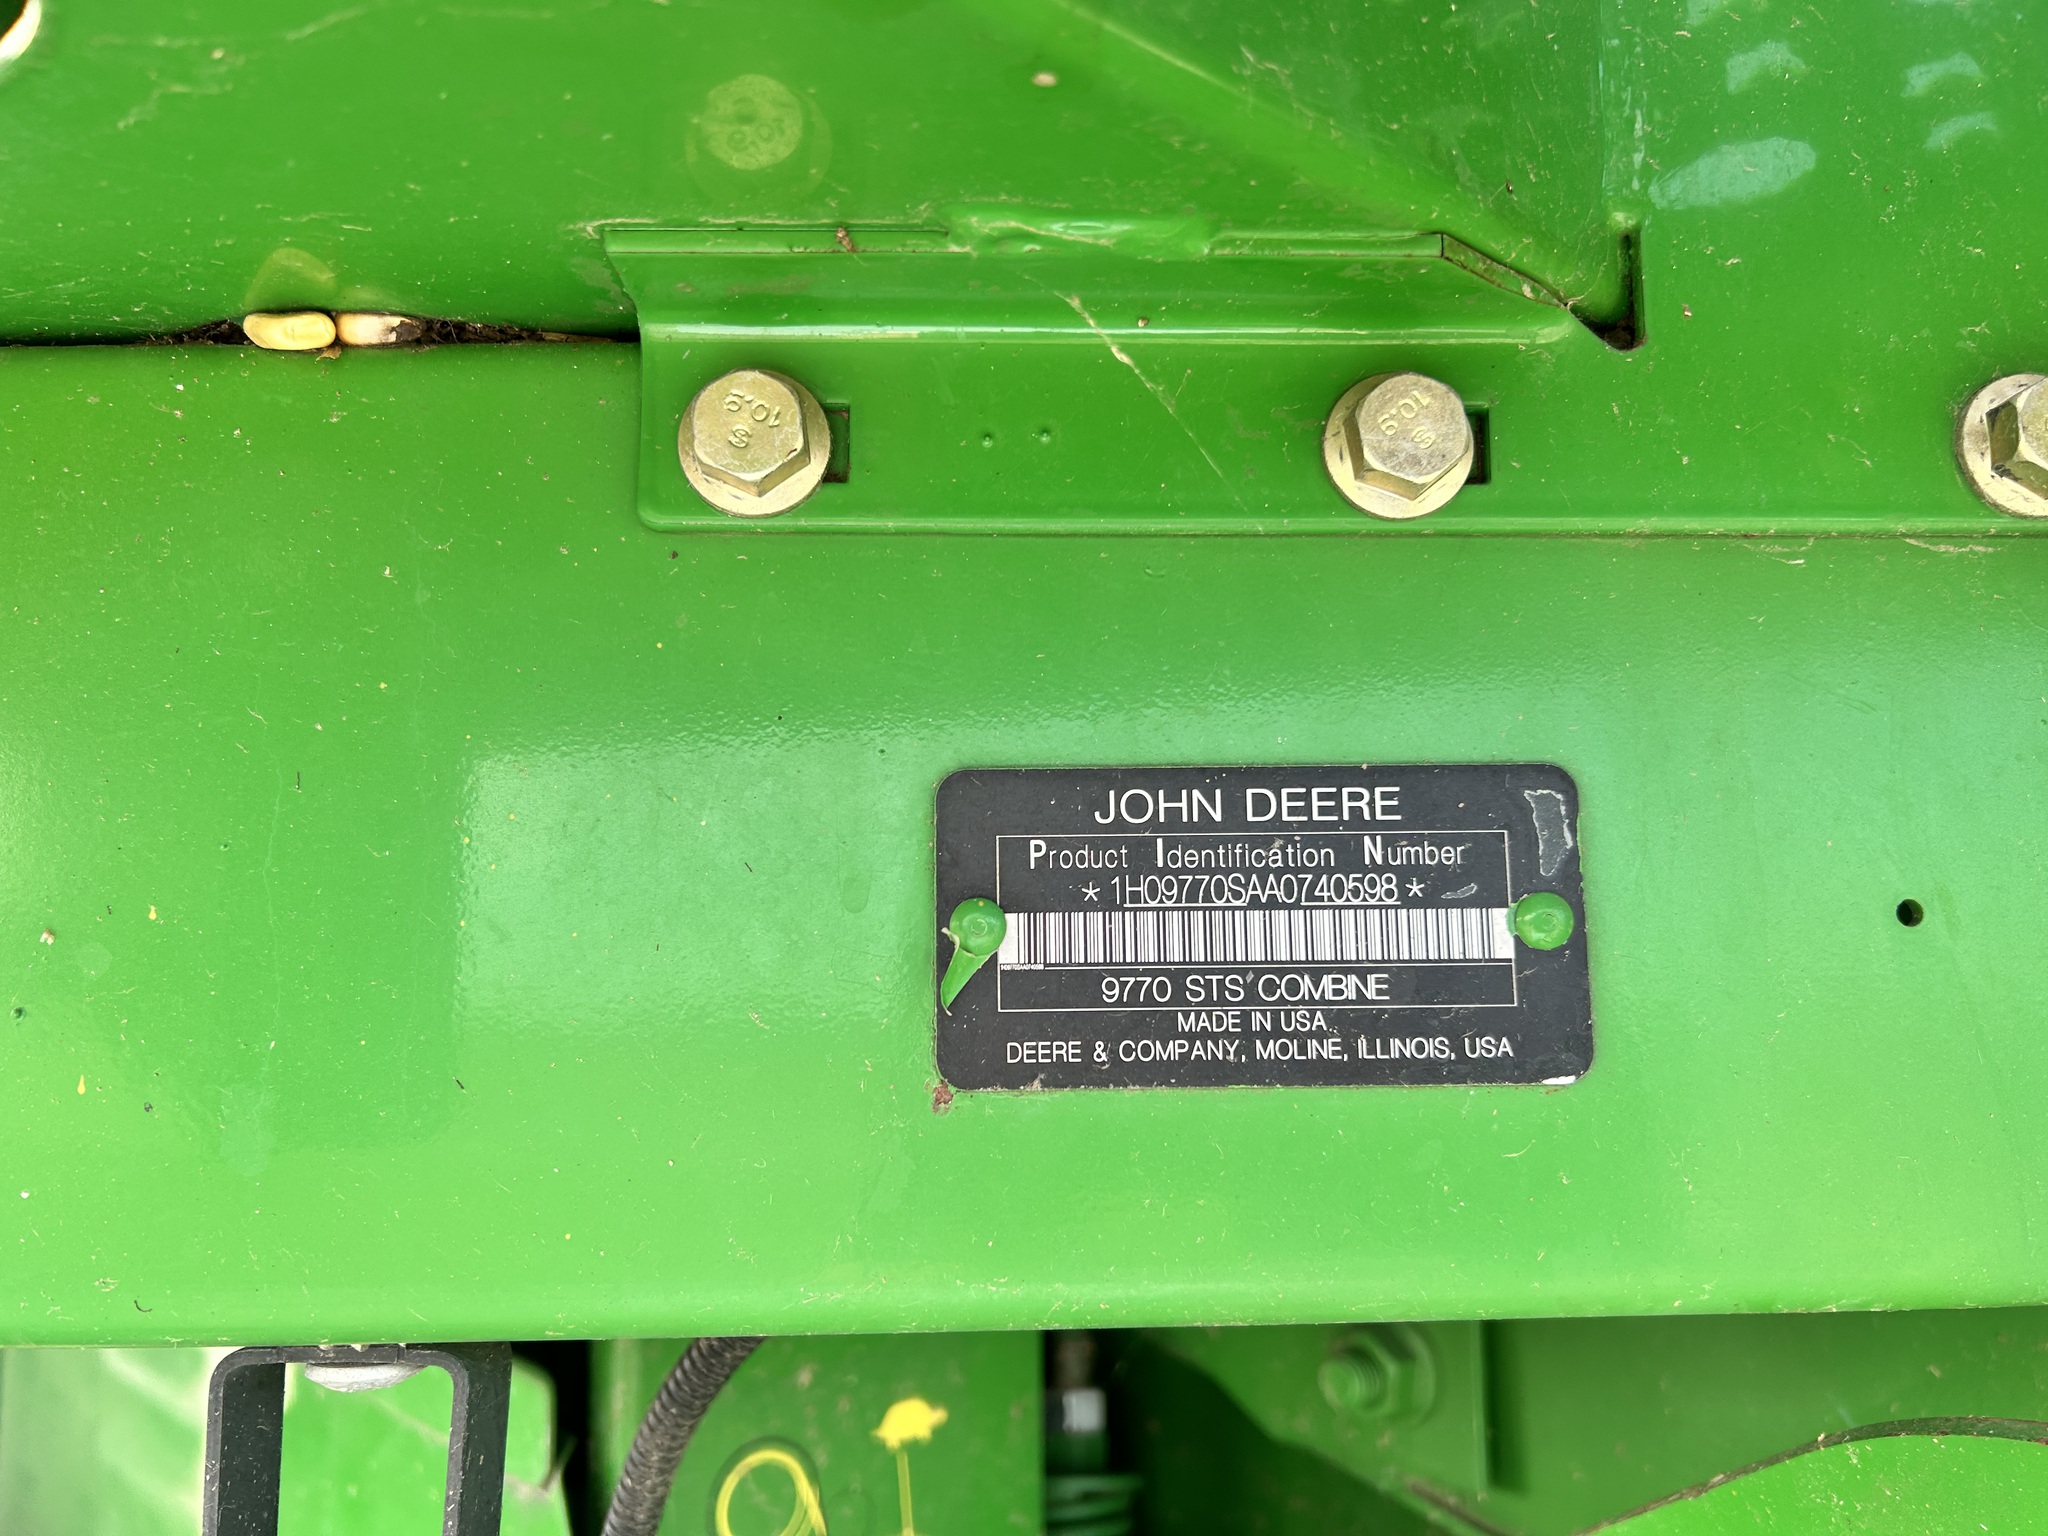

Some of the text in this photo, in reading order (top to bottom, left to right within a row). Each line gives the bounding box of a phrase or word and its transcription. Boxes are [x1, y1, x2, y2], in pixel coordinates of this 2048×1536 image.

[722, 389, 782, 428] 10.9
[1377, 389, 1433, 436] 10.9
[1094, 786, 1403, 825] JOHN DEERE
[1029, 835, 1466, 870] Product Identification Number
[1101, 973, 1391, 1003] 9770 STS COMBINE
[1177, 1010, 1328, 1033] MADE IN USA
[1006, 1036, 1515, 1064] DEERE & COMPANY, MOLINE, ILLINOIS, USA
